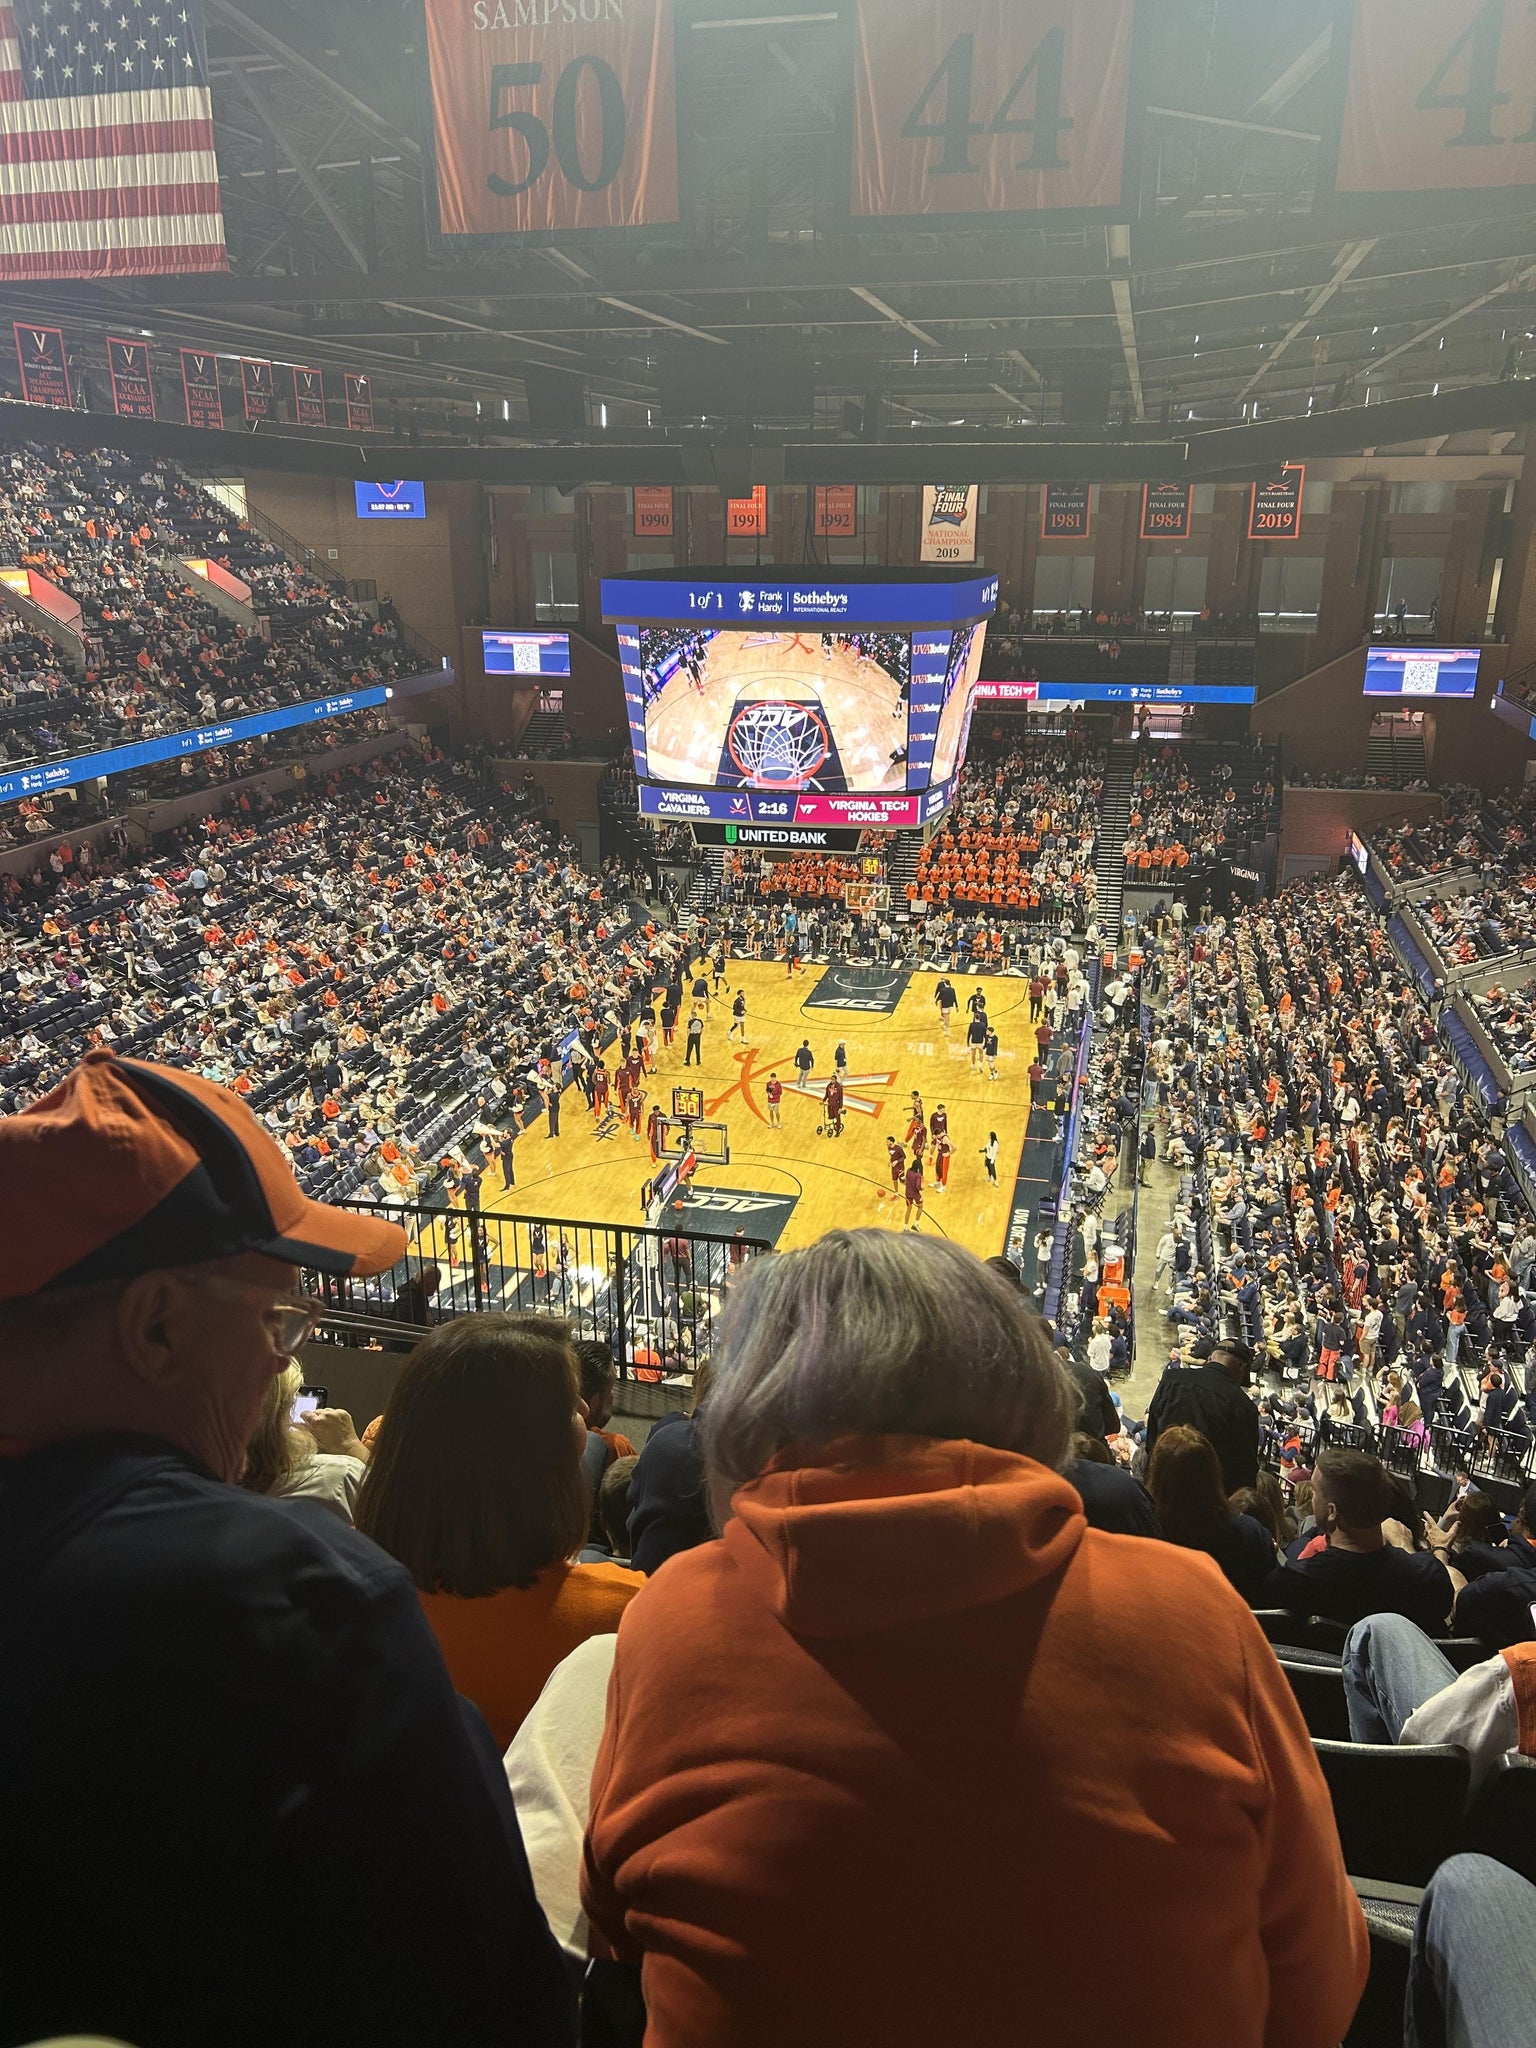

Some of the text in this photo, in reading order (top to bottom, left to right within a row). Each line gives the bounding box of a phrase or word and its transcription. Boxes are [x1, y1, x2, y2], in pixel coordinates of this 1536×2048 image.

[473, 0, 624, 31] SAMPSON
[1415, 0, 1536, 147] 4
[900, 26, 1075, 175] 44
[486, 54, 626, 197] 50
[38, 371, 52, 380] ACC
[29, 378, 64, 387] TOURNAMENT
[120, 381, 145, 396] NCAA
[29, 386, 65, 395] CHAMPIONS
[192, 389, 214, 402] NCAA
[302, 402, 321, 413] NCAA
[937, 491, 966, 502] FINAL
[934, 502, 964, 513] FOUR
[640, 514, 669, 528] 1990
[733, 514, 760, 528] 1991
[820, 514, 850, 528] 1992
[1050, 513, 1081, 528] 1981
[1149, 513, 1182, 528] 1984
[1256, 513, 1293, 528] 2019
[928, 530, 969, 538] NATIONAL
[923, 537, 973, 546] CHAMPIONS
[936, 547, 960, 558] 2019
[689, 590, 723, 609] 1 of 1
[760, 590, 783, 601] Frank
[793, 590, 848, 607] Sotheby's
[758, 602, 783, 614] Hardy
[912, 643, 950, 656] UVAToday
[911, 673, 945, 685] UVAToday
[998, 685, 1023, 696] TECH
[1156, 688, 1182, 696] Sotheby's
[910, 702, 941, 714] UVAToday
[45, 767, 70, 779] Sotheby's
[661, 791, 706, 805] VIRGINIA
[657, 802, 711, 815] CAVALIERS
[758, 802, 788, 815] 2:16
[829, 800, 909, 811] VIRGINIA TECH
[847, 811, 889, 822] HOKIES
[738, 829, 828, 845] UNITED BANK
[864, 864, 877, 874] 30
[1230, 865, 1260, 882] VIRGINIA
[809, 997, 894, 1010] ACC
[677, 1101, 696, 1116] 30
[672, 1191, 791, 1213] ACC
[1012, 1208, 1030, 1225] UVA
